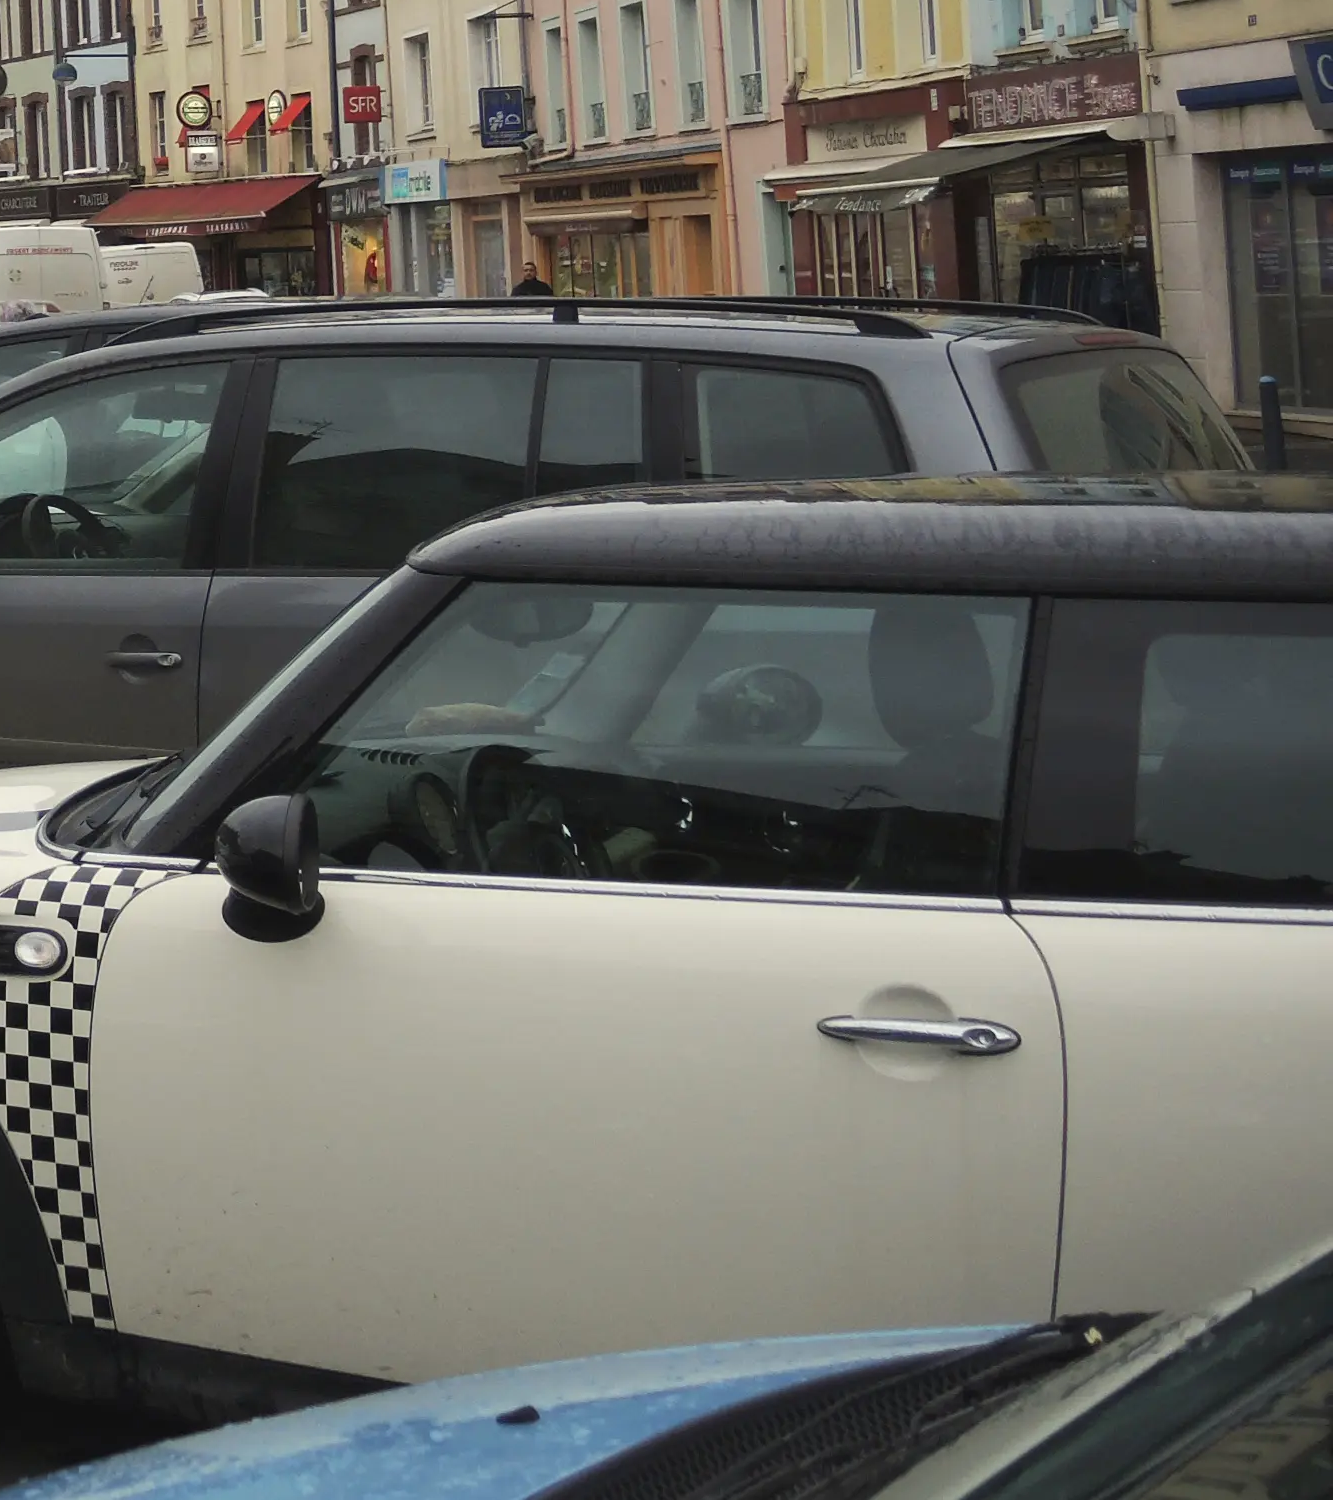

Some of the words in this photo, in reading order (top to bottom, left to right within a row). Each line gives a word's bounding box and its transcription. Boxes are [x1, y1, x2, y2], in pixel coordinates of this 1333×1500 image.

[349, 96, 377, 113] SFR
[968, 76, 1079, 130] TENDANCE
[78, 193, 110, 207] TRAITEUR
[834, 195, 882, 212] Tendance
